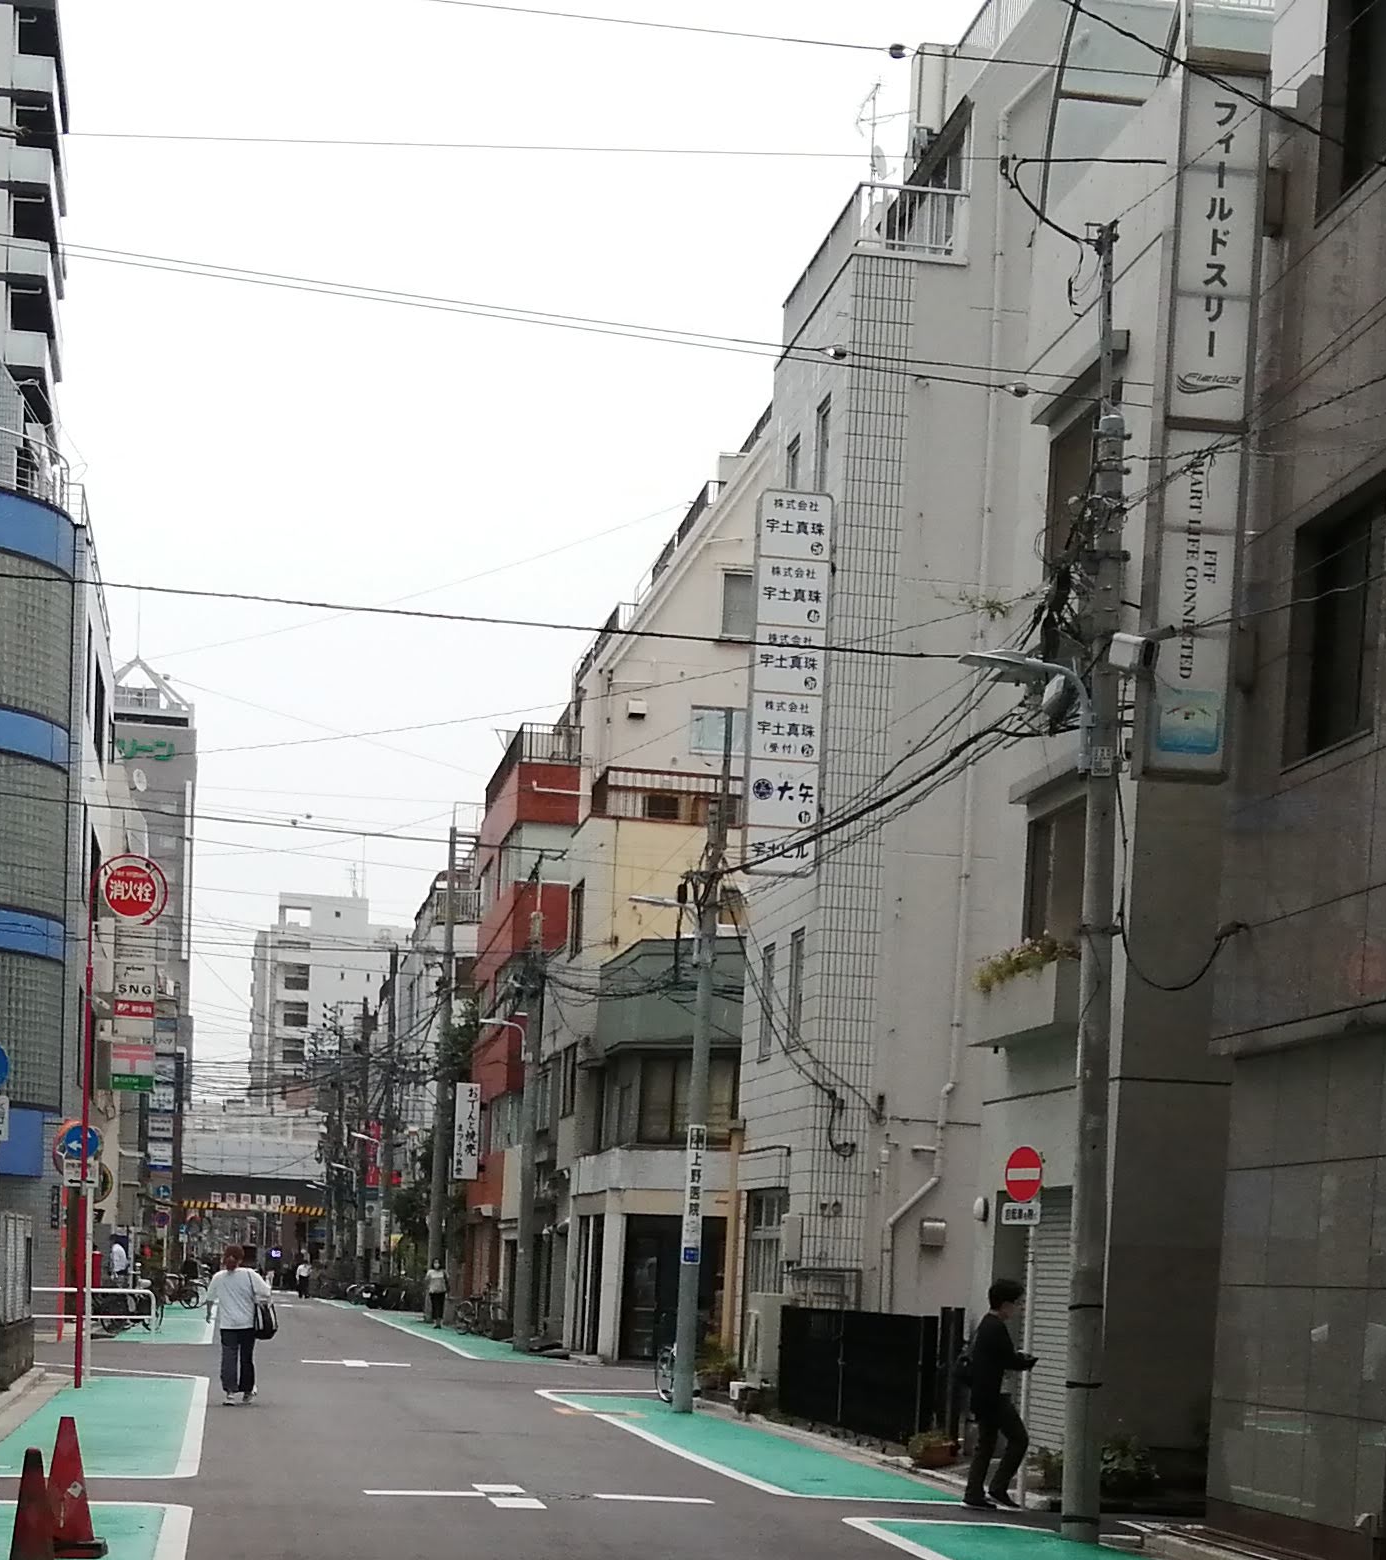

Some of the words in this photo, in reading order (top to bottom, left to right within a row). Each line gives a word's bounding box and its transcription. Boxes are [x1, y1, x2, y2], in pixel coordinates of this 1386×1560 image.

[1201, 101, 1242, 358] フィールドスリー
[1189, 453, 1205, 514] MART
[774, 499, 819, 512] 株式会社
[766, 518, 825, 536] 宇土真珠
[1186, 519, 1201, 560] LIFE
[771, 566, 816, 580] 株式会社
[763, 586, 822, 604] 宇土真珠
[1179, 565, 1198, 679] CONNETED
[760, 653, 817, 671] 宇土真珠
[765, 701, 809, 714] 株式会社
[757, 721, 815, 738] 宇土真珠
[109, 879, 153, 903] 消火栓
[118, 984, 151, 995] SNG
[688, 1152, 702, 1217] 上野医院
